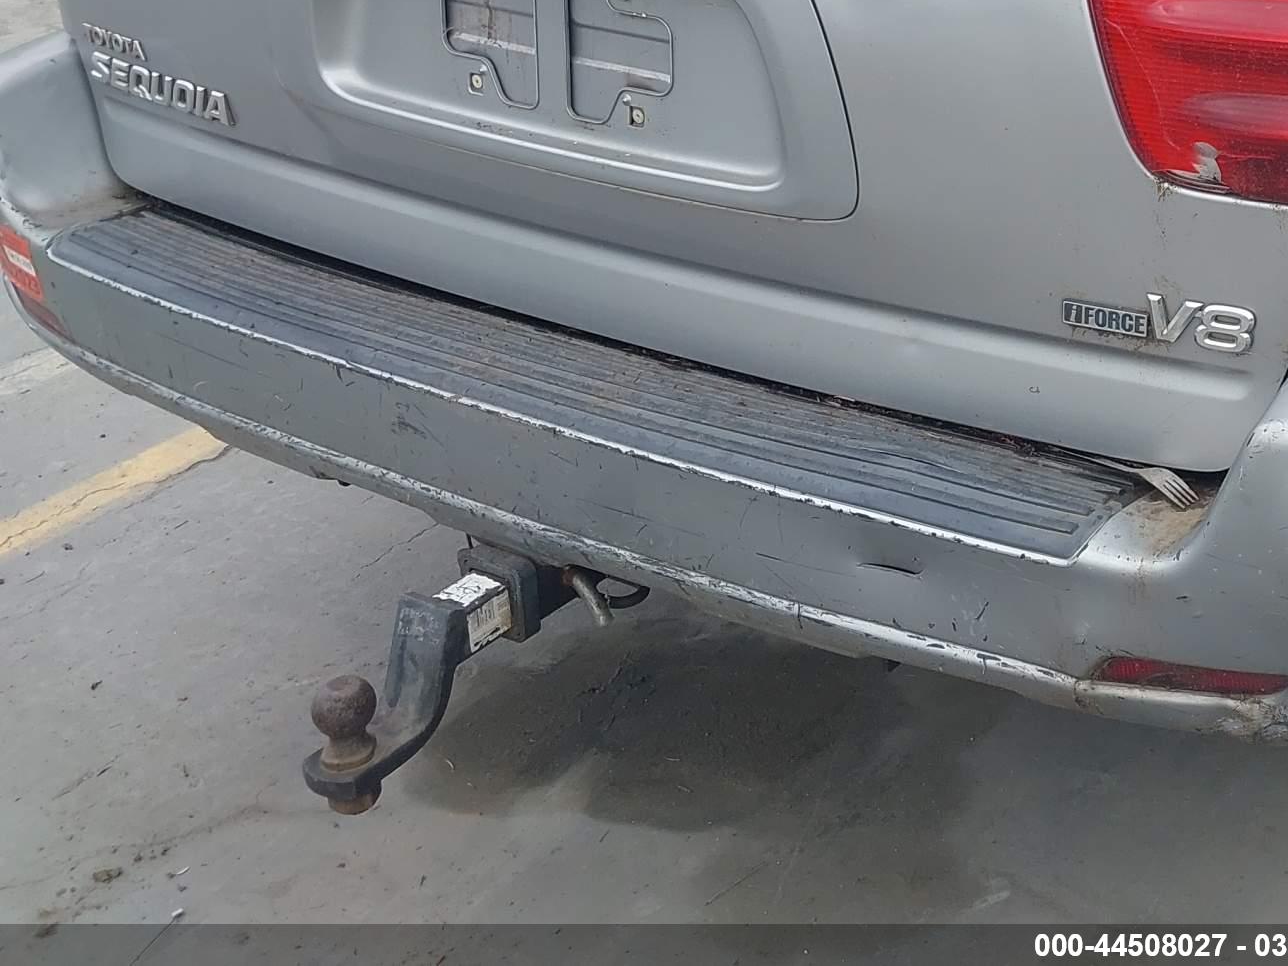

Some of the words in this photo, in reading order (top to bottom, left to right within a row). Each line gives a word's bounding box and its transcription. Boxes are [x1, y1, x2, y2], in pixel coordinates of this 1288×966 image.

[82, 22, 148, 62] TOYOTA
[91, 51, 237, 127] SEQUOIA
[1147, 292, 1257, 354] V8
